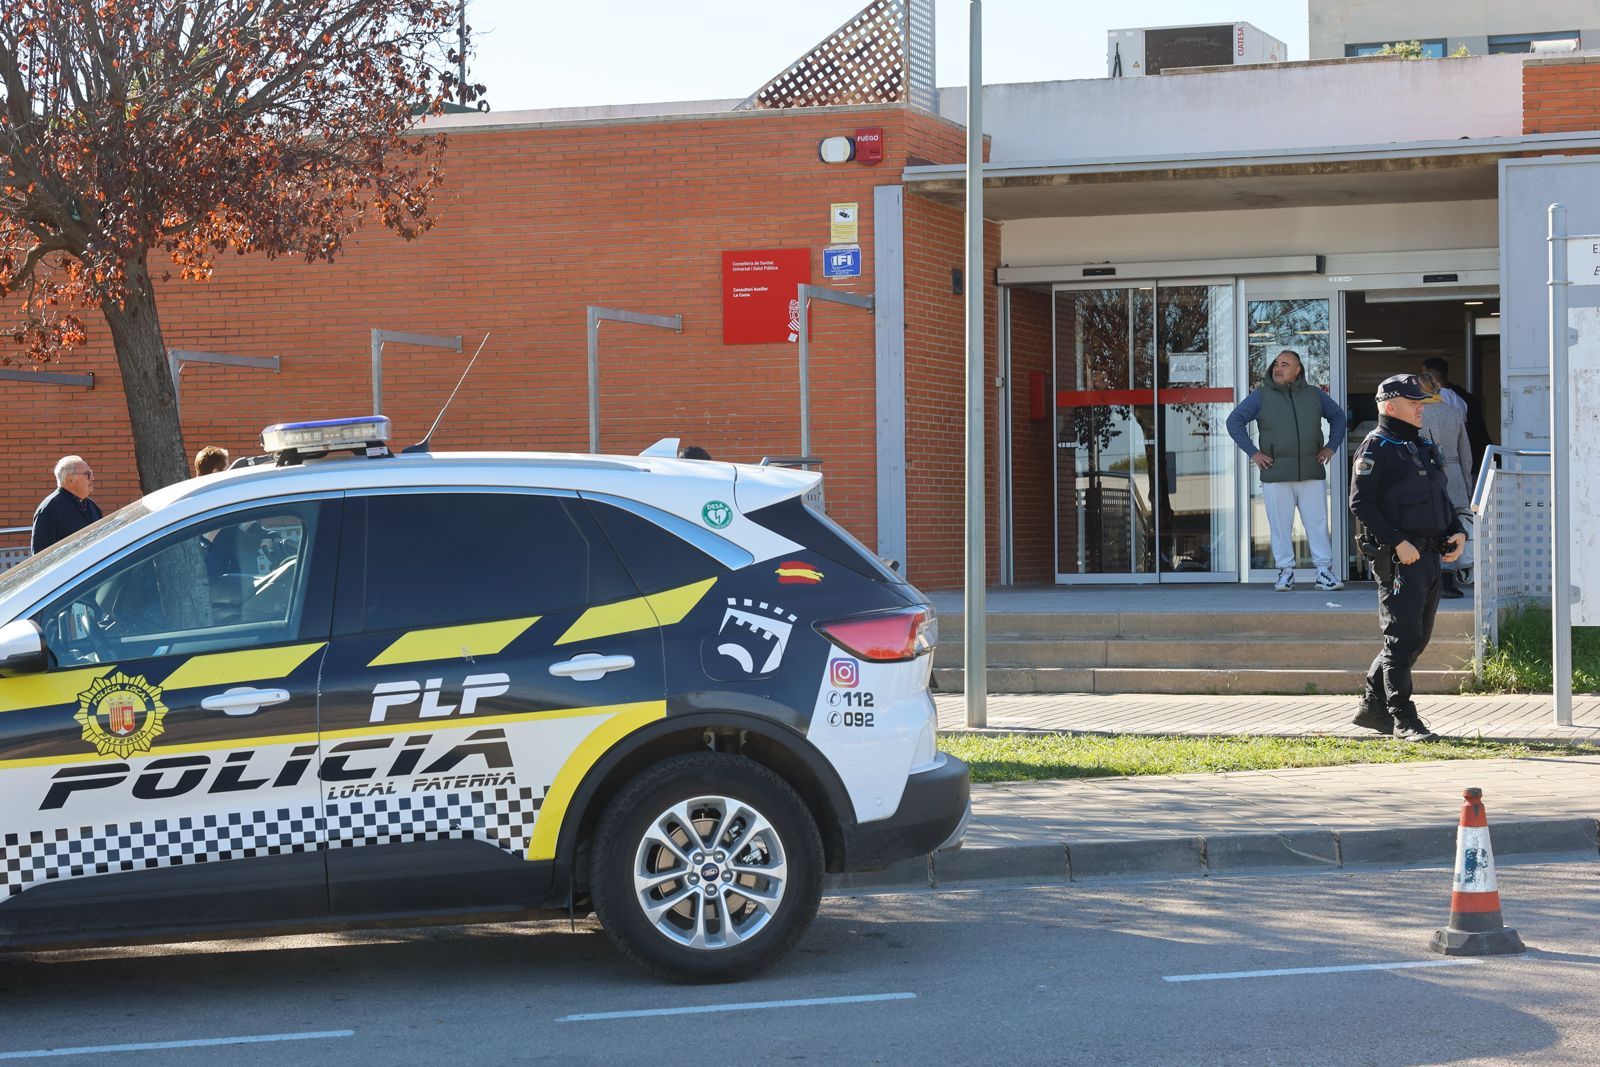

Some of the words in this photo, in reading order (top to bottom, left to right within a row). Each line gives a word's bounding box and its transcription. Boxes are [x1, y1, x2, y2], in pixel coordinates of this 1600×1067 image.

[832, 254, 853, 266] IFI
[92, 684, 121, 706] POLICIA
[124, 684, 150, 703] LOCAL
[369, 672, 511, 723] PLP
[842, 691, 874, 708] 112
[843, 711, 875, 728] 092
[98, 730, 147, 744] PATERNA
[38, 728, 514, 811] POLICIA
[327, 781, 398, 801] LOCAL
[411, 771, 517, 793] PATERNA
